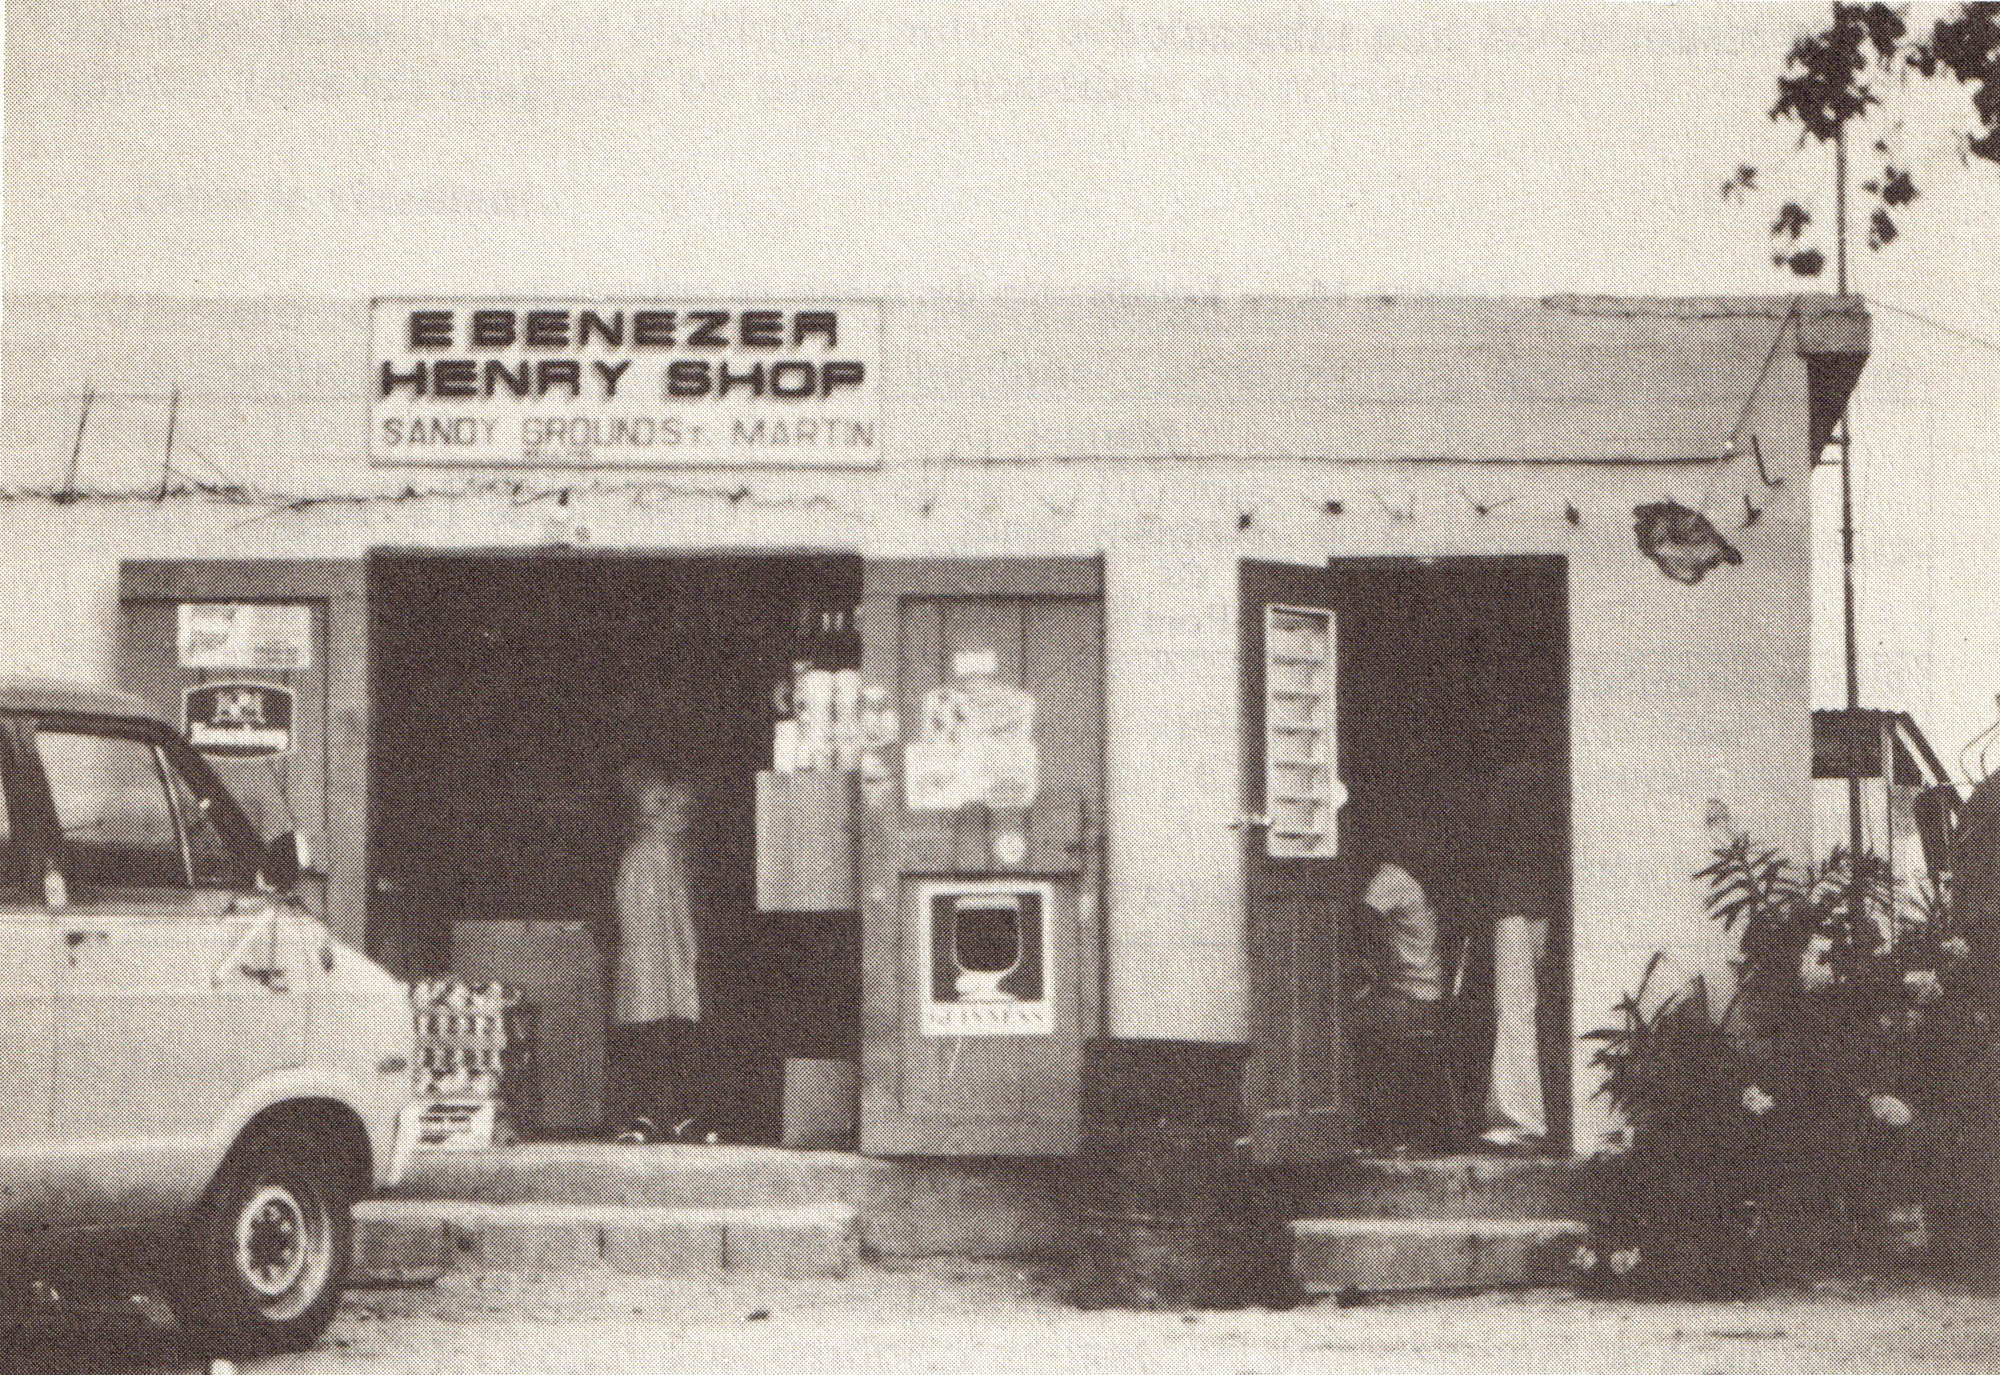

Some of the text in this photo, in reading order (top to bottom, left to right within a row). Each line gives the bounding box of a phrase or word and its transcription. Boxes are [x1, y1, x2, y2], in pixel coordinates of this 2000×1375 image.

[408, 309, 837, 349] EBENEZER
[379, 359, 866, 398] HENRY SHOP
[382, 416, 498, 448] SANDY
[522, 416, 655, 448] GROUND
[732, 418, 875, 449] MARTIN
